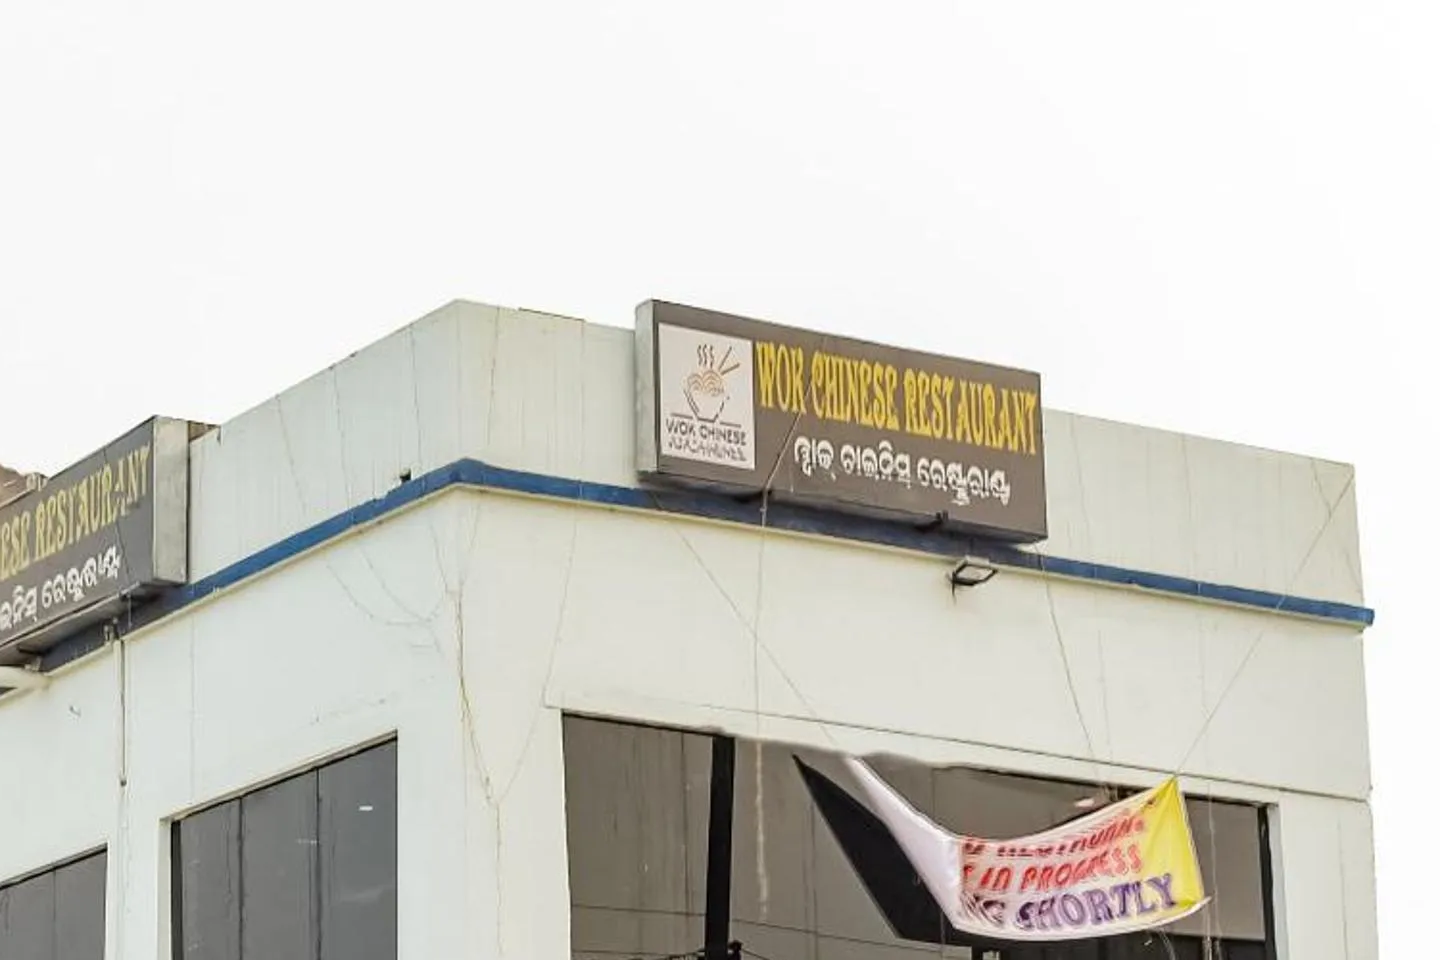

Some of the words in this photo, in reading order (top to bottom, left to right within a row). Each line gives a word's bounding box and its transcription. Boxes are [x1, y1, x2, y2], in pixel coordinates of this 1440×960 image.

[757, 342, 806, 414] WOK
[811, 351, 899, 431] CHINESE
[904, 369, 1038, 455] RESTAURANT
[665, 418, 696, 436] WOK
[699, 425, 746, 446] CHINESE
[34, 446, 152, 562] RESTAURANT
[1020, 843, 1142, 894] PROGRESS
[1015, 873, 1179, 930] SHORTLY
